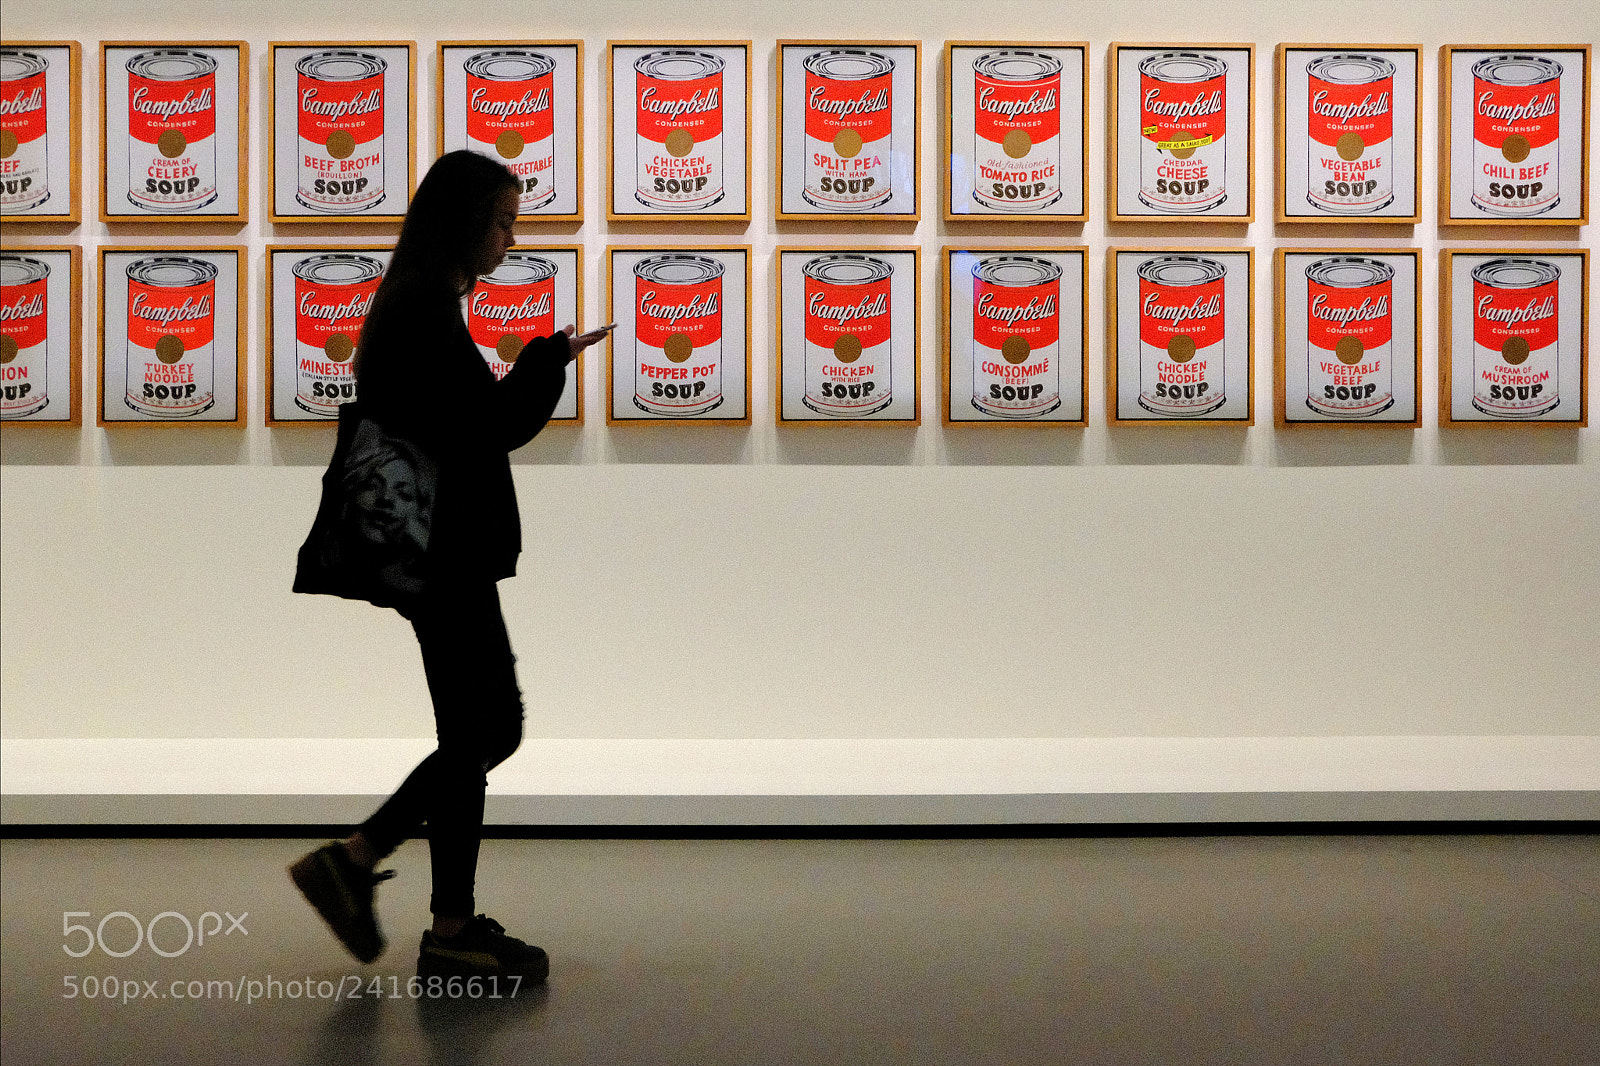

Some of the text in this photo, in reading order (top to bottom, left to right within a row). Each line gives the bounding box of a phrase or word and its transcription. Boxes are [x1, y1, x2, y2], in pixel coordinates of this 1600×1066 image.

[153, 159, 179, 167] CREAM
[305, 153, 379, 172] BEEF BROTH
[507, 156, 552, 176] VEGETABLE
[654, 156, 704, 167] CHICKEN
[813, 153, 881, 171] SPLIT PEA
[1164, 159, 1202, 167] CHEDDAR
[1321, 158, 1381, 171] VEGETABLE
[148, 164, 197, 179] CELERY
[646, 162, 712, 178] VEGETABLE
[980, 165, 1055, 183] TOMATO RICE
[1157, 166, 1207, 180] CHEESE
[1334, 172, 1365, 181] BEAN
[1484, 162, 1549, 180] CHILI BEEF
[146, 178, 199, 194] SOUP
[314, 178, 368, 195] SOUP
[654, 177, 707, 193] SOUP
[821, 178, 874, 194] SOUP
[993, 183, 1045, 199] SOUP
[1157, 179, 1208, 195] SOUP
[1326, 180, 1377, 196] SOUP
[1490, 182, 1542, 199] SOUP
[145, 363, 193, 375] TURKEY
[641, 363, 716, 379] PEPPER POT
[823, 365, 874, 377] CHICKEN
[982, 358, 1048, 378] CONSOMMÉ
[1158, 361, 1206, 373] CHICKEN
[1320, 361, 1380, 375] VEGETABLE
[1495, 366, 1520, 374] CREAM
[145, 372, 194, 383] NOODLE
[1159, 371, 1204, 384] NOODLE
[1334, 375, 1362, 385] BEEF
[1482, 371, 1549, 385] MUSHROOM
[143, 383, 196, 399] SOUP
[652, 381, 705, 399] SOUP
[822, 382, 875, 399] SOUP
[990, 384, 1043, 401] SOUP
[1156, 382, 1208, 399] SOUP
[1325, 383, 1376, 400] SOUP
[1490, 384, 1542, 400] SOUP
